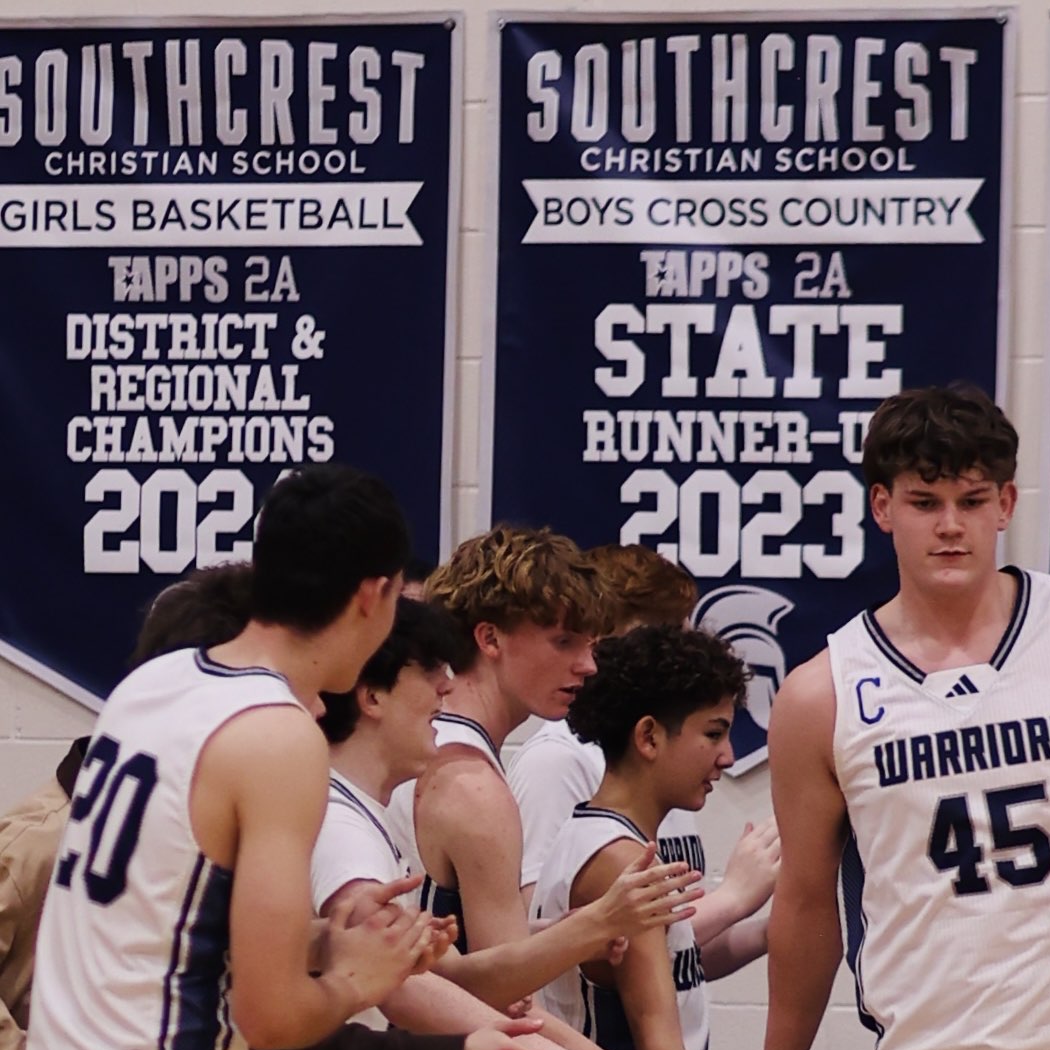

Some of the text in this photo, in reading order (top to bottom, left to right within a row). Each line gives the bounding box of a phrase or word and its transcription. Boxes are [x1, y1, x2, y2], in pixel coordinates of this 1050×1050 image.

[0, 39, 425, 147] SOUTHCREST
[526, 33, 978, 143] SOUTHCREST
[44, 149, 366, 176] CHRISTIAN SCHOOL
[580, 146, 916, 173] CHRISTIAN SCHOOL
[1, 198, 404, 232] GIRLS BASKETBALL
[543, 197, 962, 227] BOYS CROSS COUNTRY
[108, 256, 300, 303] TAPPS 2A
[640, 250, 852, 299] TAPPS 2A
[66, 313, 326, 360] DISTRICT &
[594, 303, 903, 398] STATE
[91, 365, 310, 411] REGIONAL
[66, 416, 334, 462] CHAMPIONS
[583, 410, 876, 463] RUNNER-U
[84, 469, 302, 573] 202
[620, 470, 865, 578] 2023
[856, 677, 885, 725] C
[55, 732, 159, 906] 20
